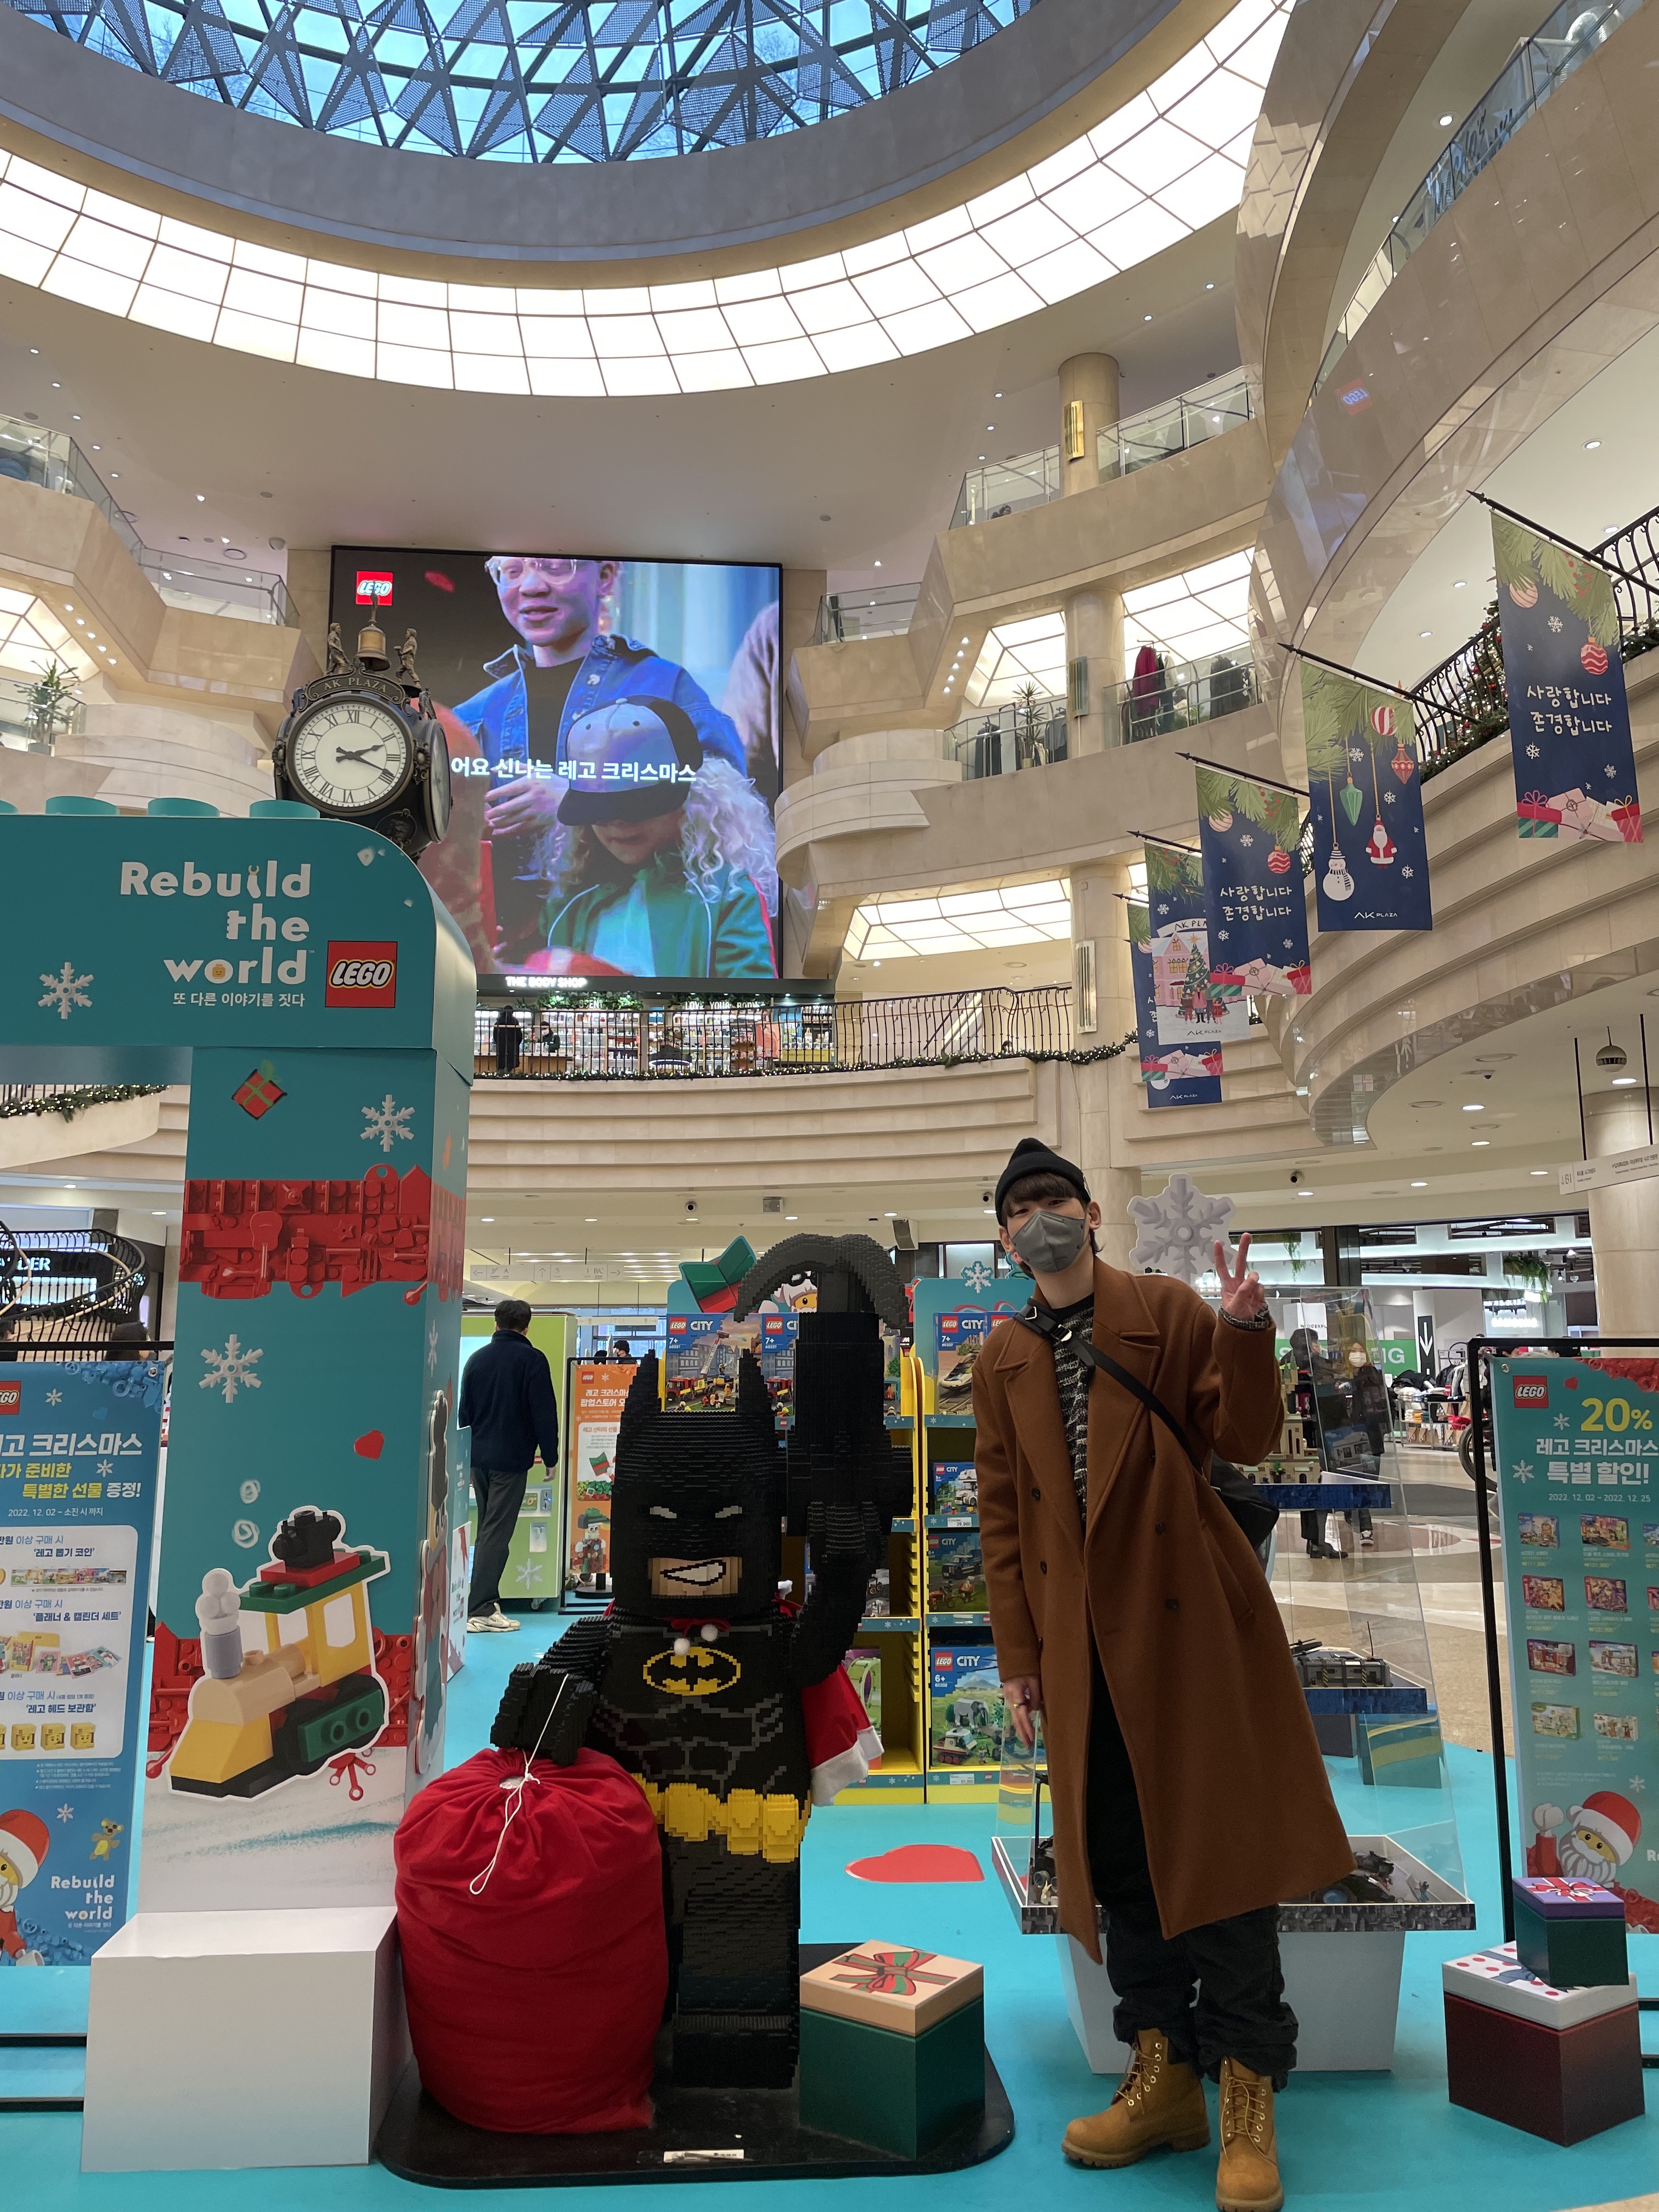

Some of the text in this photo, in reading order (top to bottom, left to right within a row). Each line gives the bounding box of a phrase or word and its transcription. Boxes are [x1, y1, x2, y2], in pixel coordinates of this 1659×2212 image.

[358, 580, 391, 596] LEGO
[324, 677, 386, 693] AK PLAZA
[1527, 685, 1612, 709] 사랑합니다
[1530, 711, 1613, 736] 존경합니다
[450, 757, 697, 783] 어요 신나는 레고 크리스마스
[120, 860, 311, 898] Rebuild
[1220, 885, 1293, 902] 사랑합니다
[1222, 905, 1292, 921] 존경합니다
[226, 903, 310, 942] the
[1175, 921, 1189, 931] AK
[163, 946, 307, 985] world
[330, 960, 393, 987] LEGO
[505, 976, 588, 988] THE BODY SHOP
[172, 992, 306, 1007] 또 다른 이야기를 짓다
[670, 1320, 714, 1331] LEGO CITY
[766, 1321, 782, 1329] LEGO
[941, 1319, 985, 1330] LEGO CITY
[0, 1391, 18, 1404] GO
[1516, 1385, 1546, 1398] LEGO
[1581, 1397, 1653, 1432] 20%
[29, 1432, 143, 1456] 크리스마스
[1536, 1438, 1659, 1457] 레고 크리스마스
[25, 1462, 72, 1479] 준비한
[1547, 1460, 1650, 1485] 특별 할인!
[22, 1482, 142, 1499] 특별한 선물 증정!
[46, 1509, 56, 1517] 02
[64, 1508, 79, 1517] 소진
[89, 1507, 104, 1516] 까지
[16, 1536, 33, 1545] 이상
[36, 1536, 53, 1544] 구매
[55, 1535, 64, 1544] 시
[15, 1599, 32, 1609] 이상
[34, 1599, 52, 1609] 구매
[54, 1599, 63, 1608] 시
[64, 1613, 71, 1622] &
[936, 1655, 981, 1667] LEGO CITY
[935, 1674, 946, 1683] 6+
[7, 1691, 25, 1701] 이상
[27, 1691, 45, 1700] 구매
[46, 1690, 55, 1700] 시
[48, 1704, 65, 1713] 헤드
[50, 1874, 115, 1889] Rebuild
[85, 1890, 114, 1905] the
[65, 1905, 113, 1920] world
